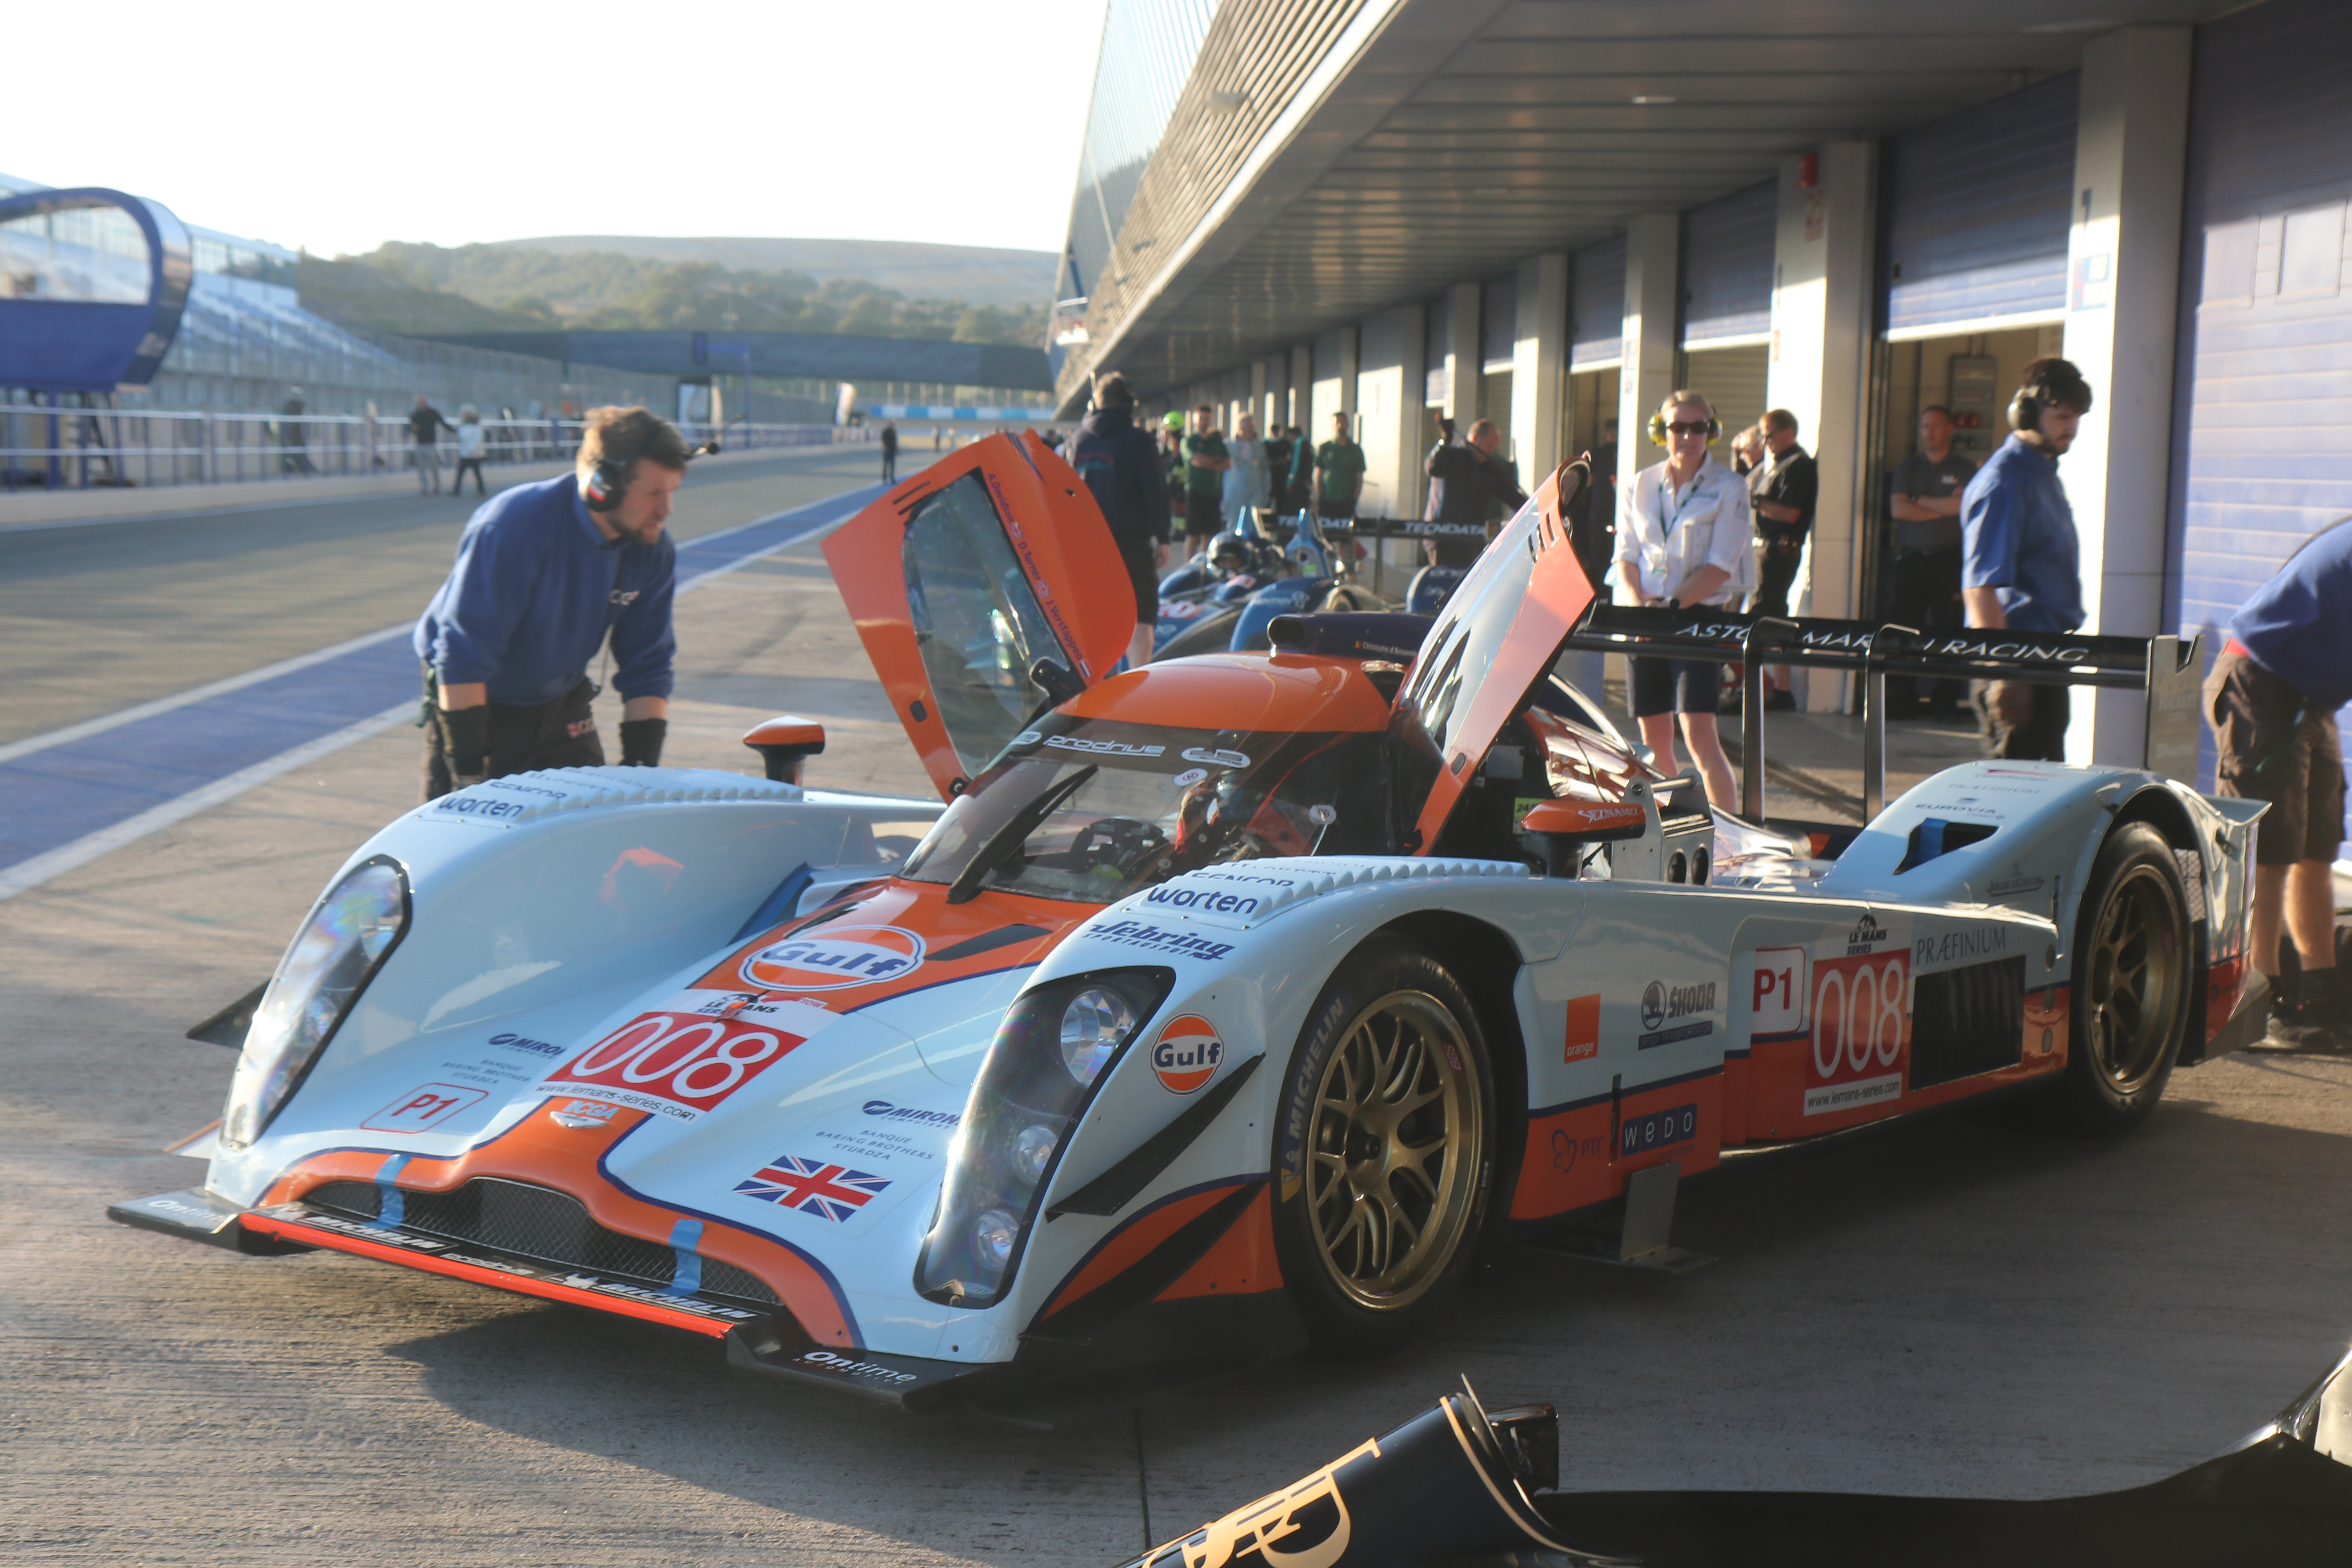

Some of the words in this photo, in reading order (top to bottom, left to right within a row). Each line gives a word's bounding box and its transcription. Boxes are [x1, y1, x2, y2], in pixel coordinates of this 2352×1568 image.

[1022, 550, 1042, 581] Turner
[1940, 639, 2089, 662] RACING
[1043, 734, 1166, 754] prodrive
[439, 797, 523, 818] worten
[1147, 887, 1258, 915] worten
[1089, 921, 1236, 960] Sebring
[1847, 943, 1873, 956] SERIES
[1849, 933, 1859, 944] LE
[1861, 928, 1887, 943] MANS
[762, 942, 908, 976] Gulf
[800, 998, 823, 1008] TOW
[1752, 967, 1793, 1012] P1
[742, 1004, 779, 1013] ANS
[1813, 958, 1905, 1079] 008
[571, 1016, 779, 1098] 008
[1154, 1043, 1221, 1067] Gulf
[1567, 1042, 1594, 1056] orange
[1288, 998, 1344, 1139] MICHELIN
[391, 1093, 460, 1120] P1
[534, 1083, 697, 1122] www.lemans-series.com
[1807, 1080, 1900, 1109] www.lemans-series.com
[816, 1131, 865, 1145] BARING
[869, 1140, 935, 1160] BROTHERS
[860, 1130, 913, 1144] BANQUE
[832, 1143, 891, 1161] STURDZA
[306, 1216, 446, 1249] MICHELIN
[600, 1283, 758, 1319] MICHELIN
[804, 1350, 918, 1382] Ontime
